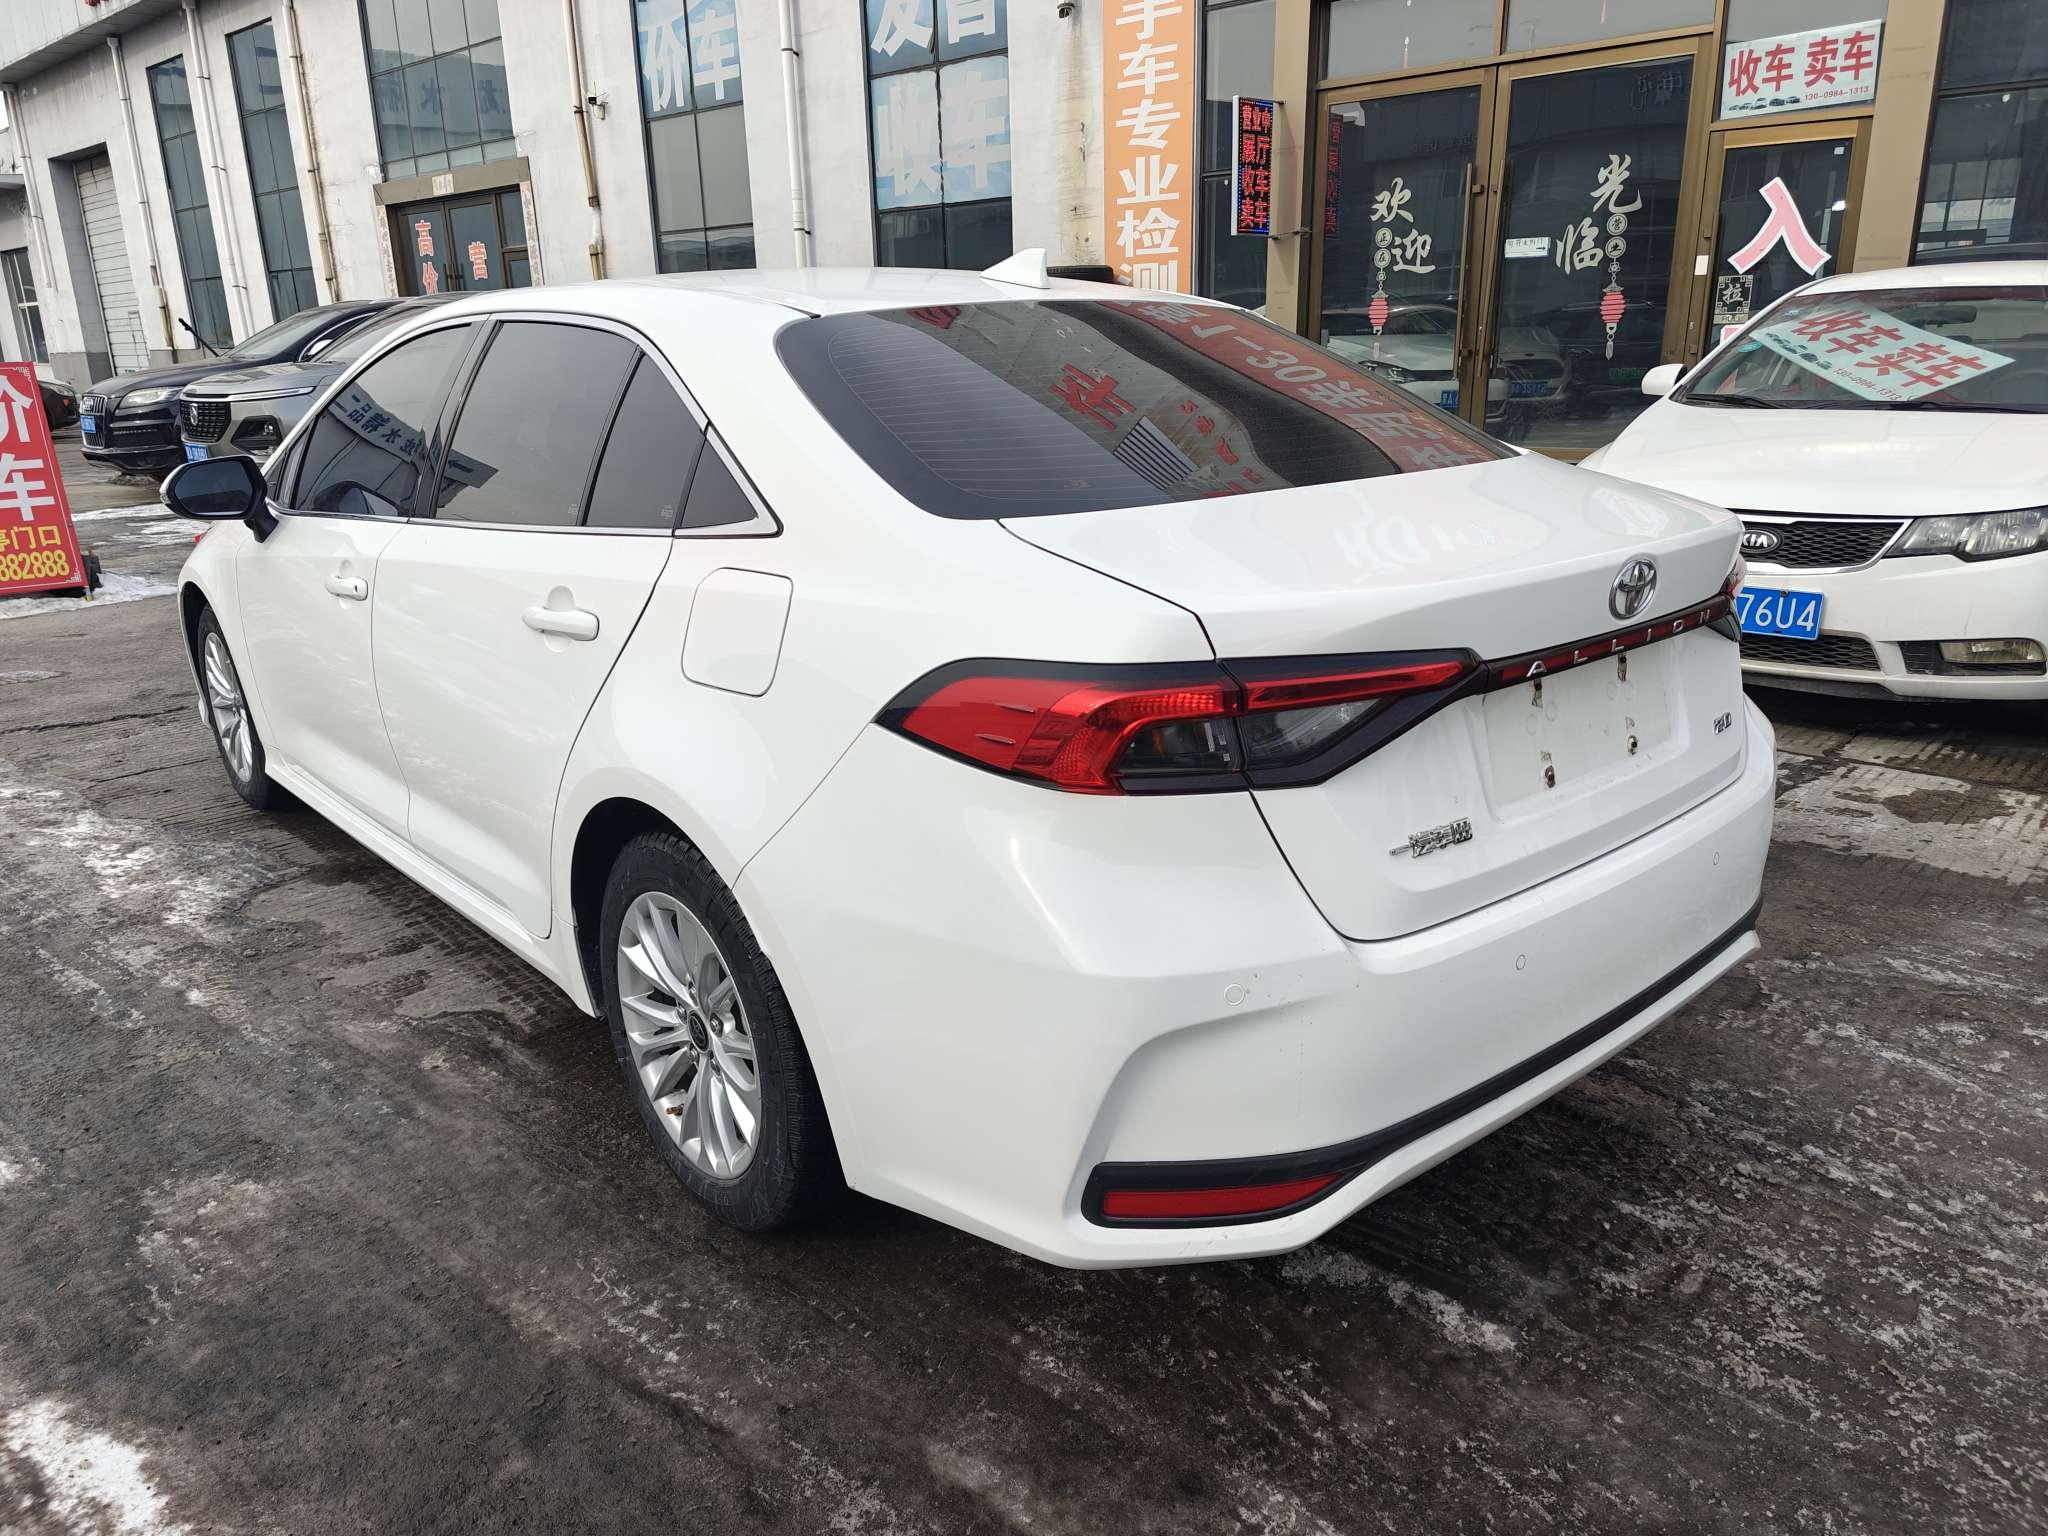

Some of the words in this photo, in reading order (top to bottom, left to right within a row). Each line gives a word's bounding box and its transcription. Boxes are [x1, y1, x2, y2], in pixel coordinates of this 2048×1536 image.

[1728, 44, 1796, 97] 收车
[1803, 31, 1876, 88] 卖车
[1803, 85, 1870, 101] 130-0984-1313
[875, 70, 1010, 197] 收车
[1370, 176, 1437, 274] 欢迎
[1555, 154, 1643, 275] 光临
[1790, 310, 1905, 354] 收车
[1855, 342, 1988, 388] 卖车
[1526, 609, 1711, 677] ALLION
